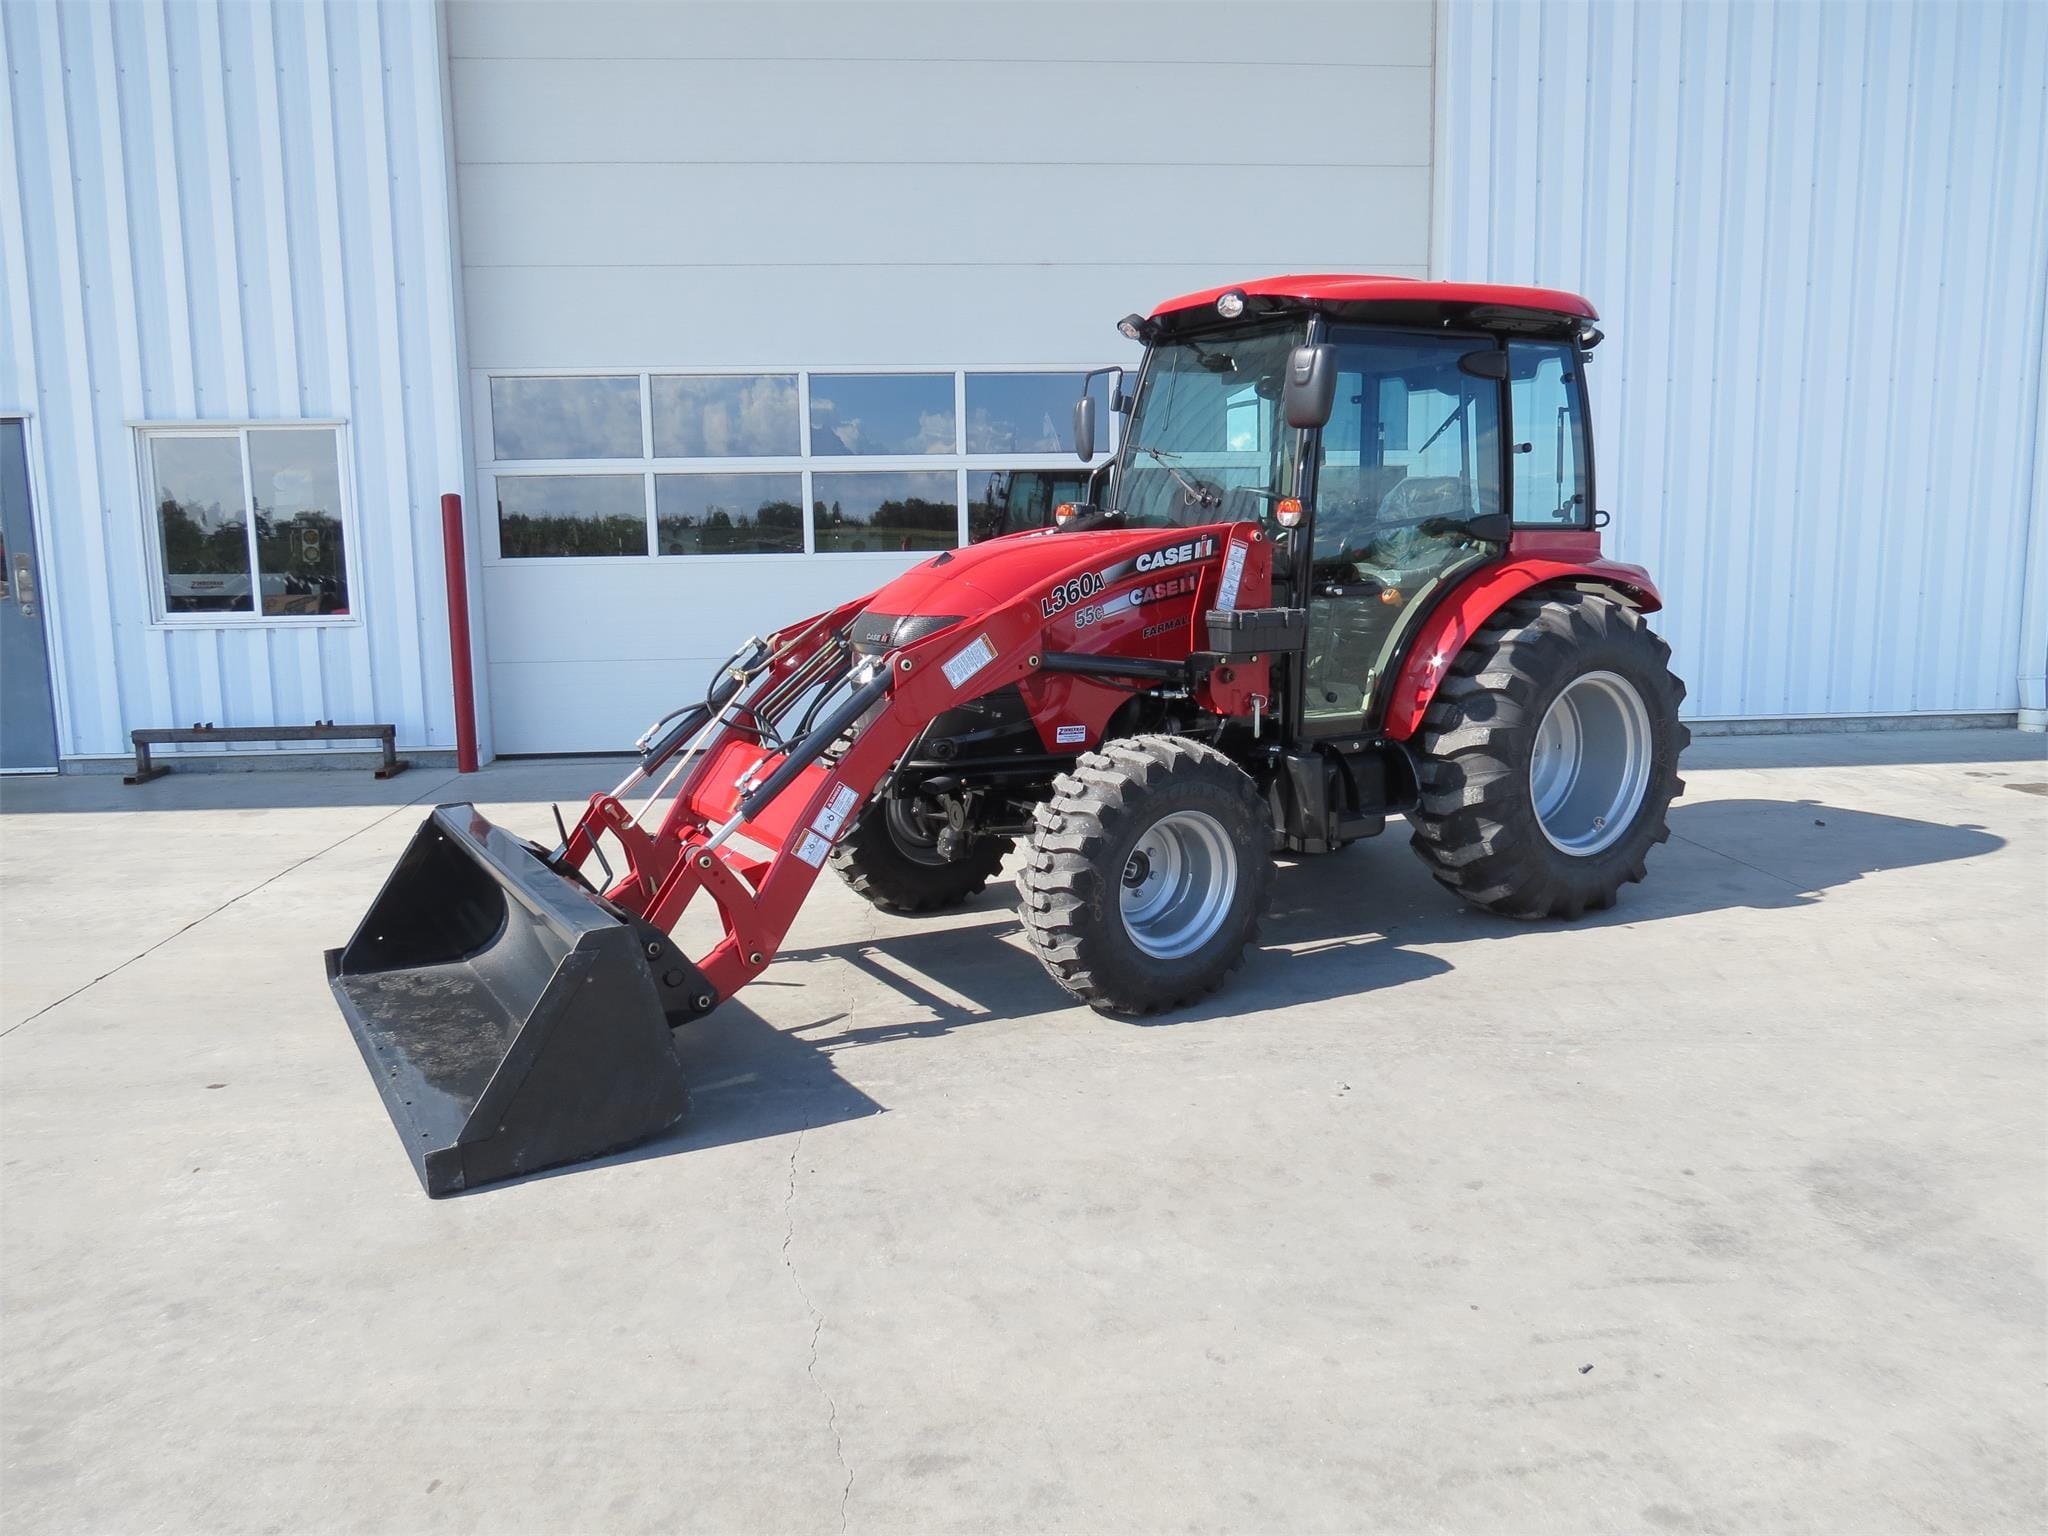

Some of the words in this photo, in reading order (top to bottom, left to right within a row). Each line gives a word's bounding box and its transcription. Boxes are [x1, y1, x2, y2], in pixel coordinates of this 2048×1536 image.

[1136, 544, 1193, 573] CASE
[1041, 572, 1106, 619] L360A
[1129, 581, 1179, 606] CASE
